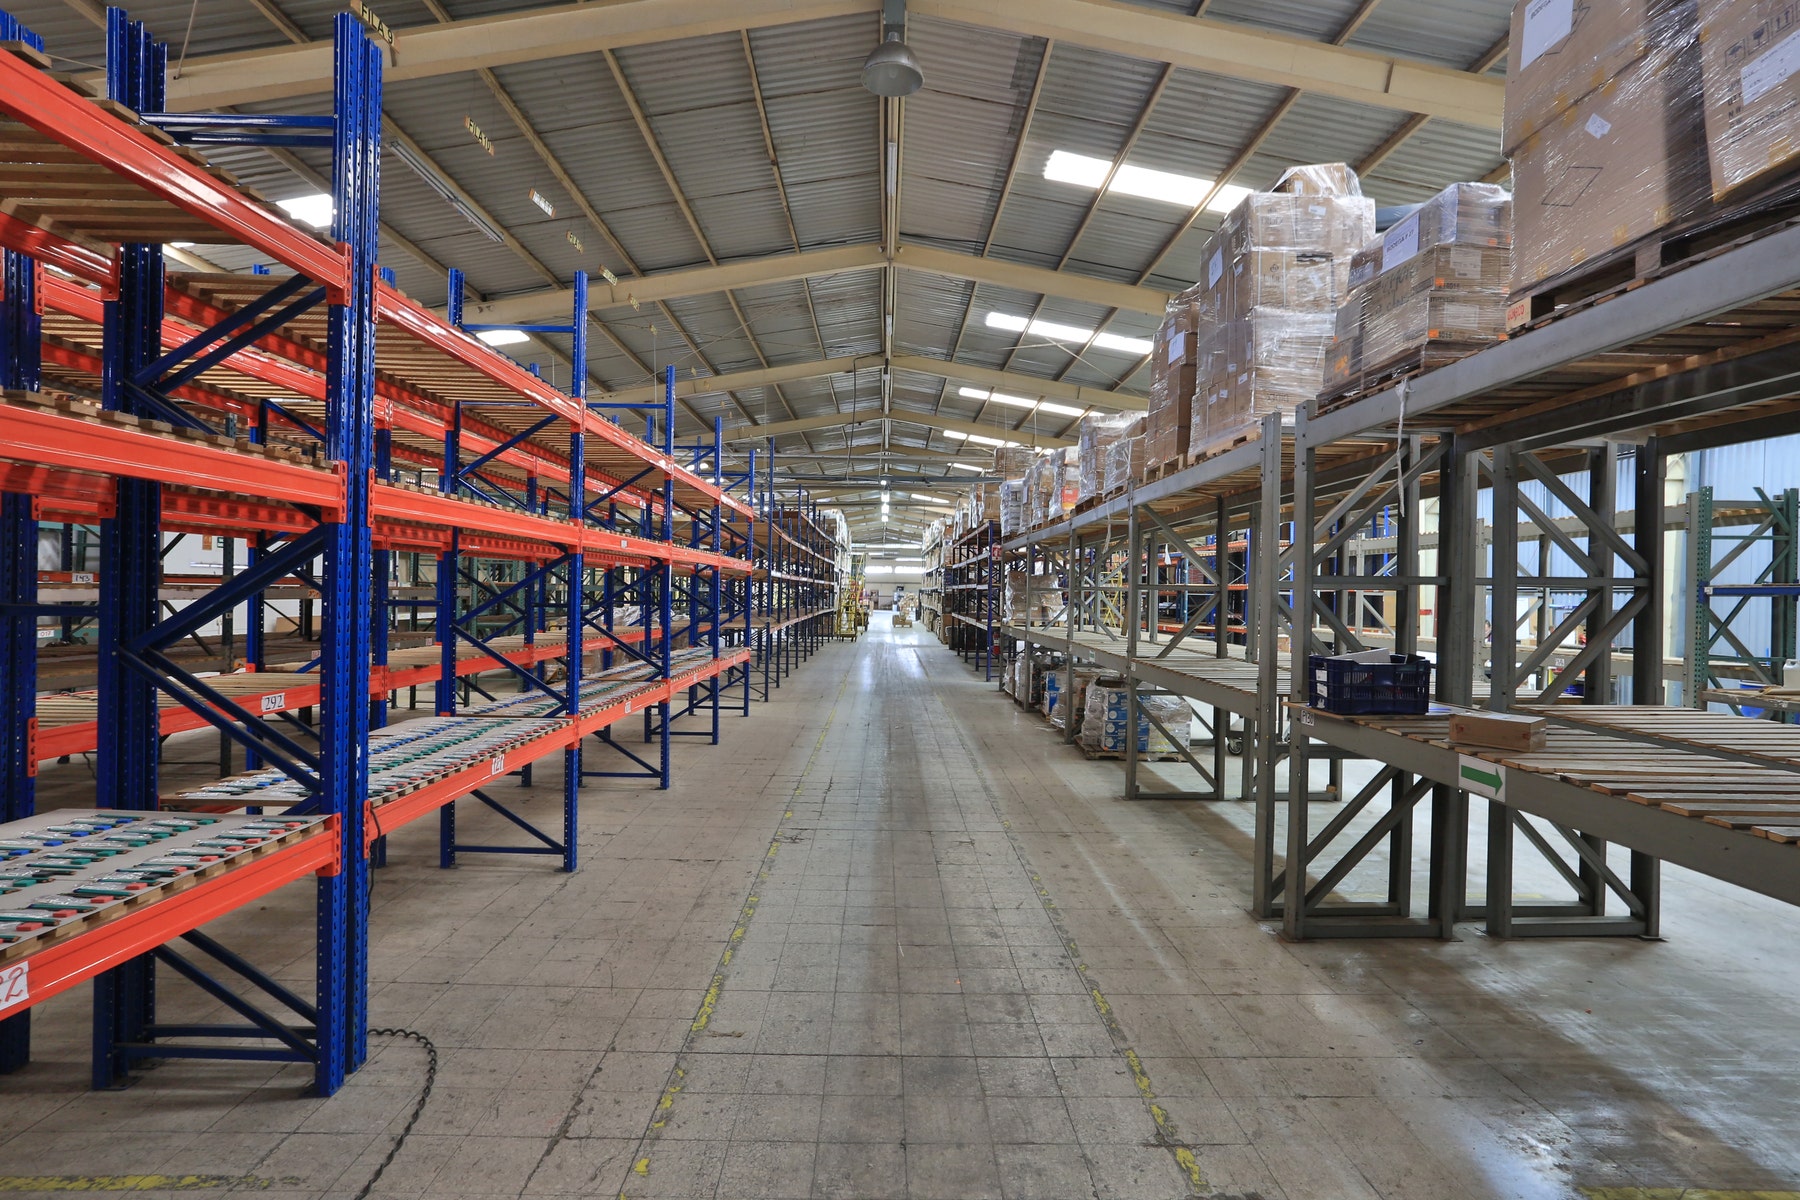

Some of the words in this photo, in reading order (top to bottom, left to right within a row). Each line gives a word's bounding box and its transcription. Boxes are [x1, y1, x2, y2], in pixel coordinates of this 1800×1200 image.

[362, 3, 384, 37] FILA
[388, 29, 393, 44] 9
[265, 694, 283, 710] 292
[0, 966, 24, 1003] 2
